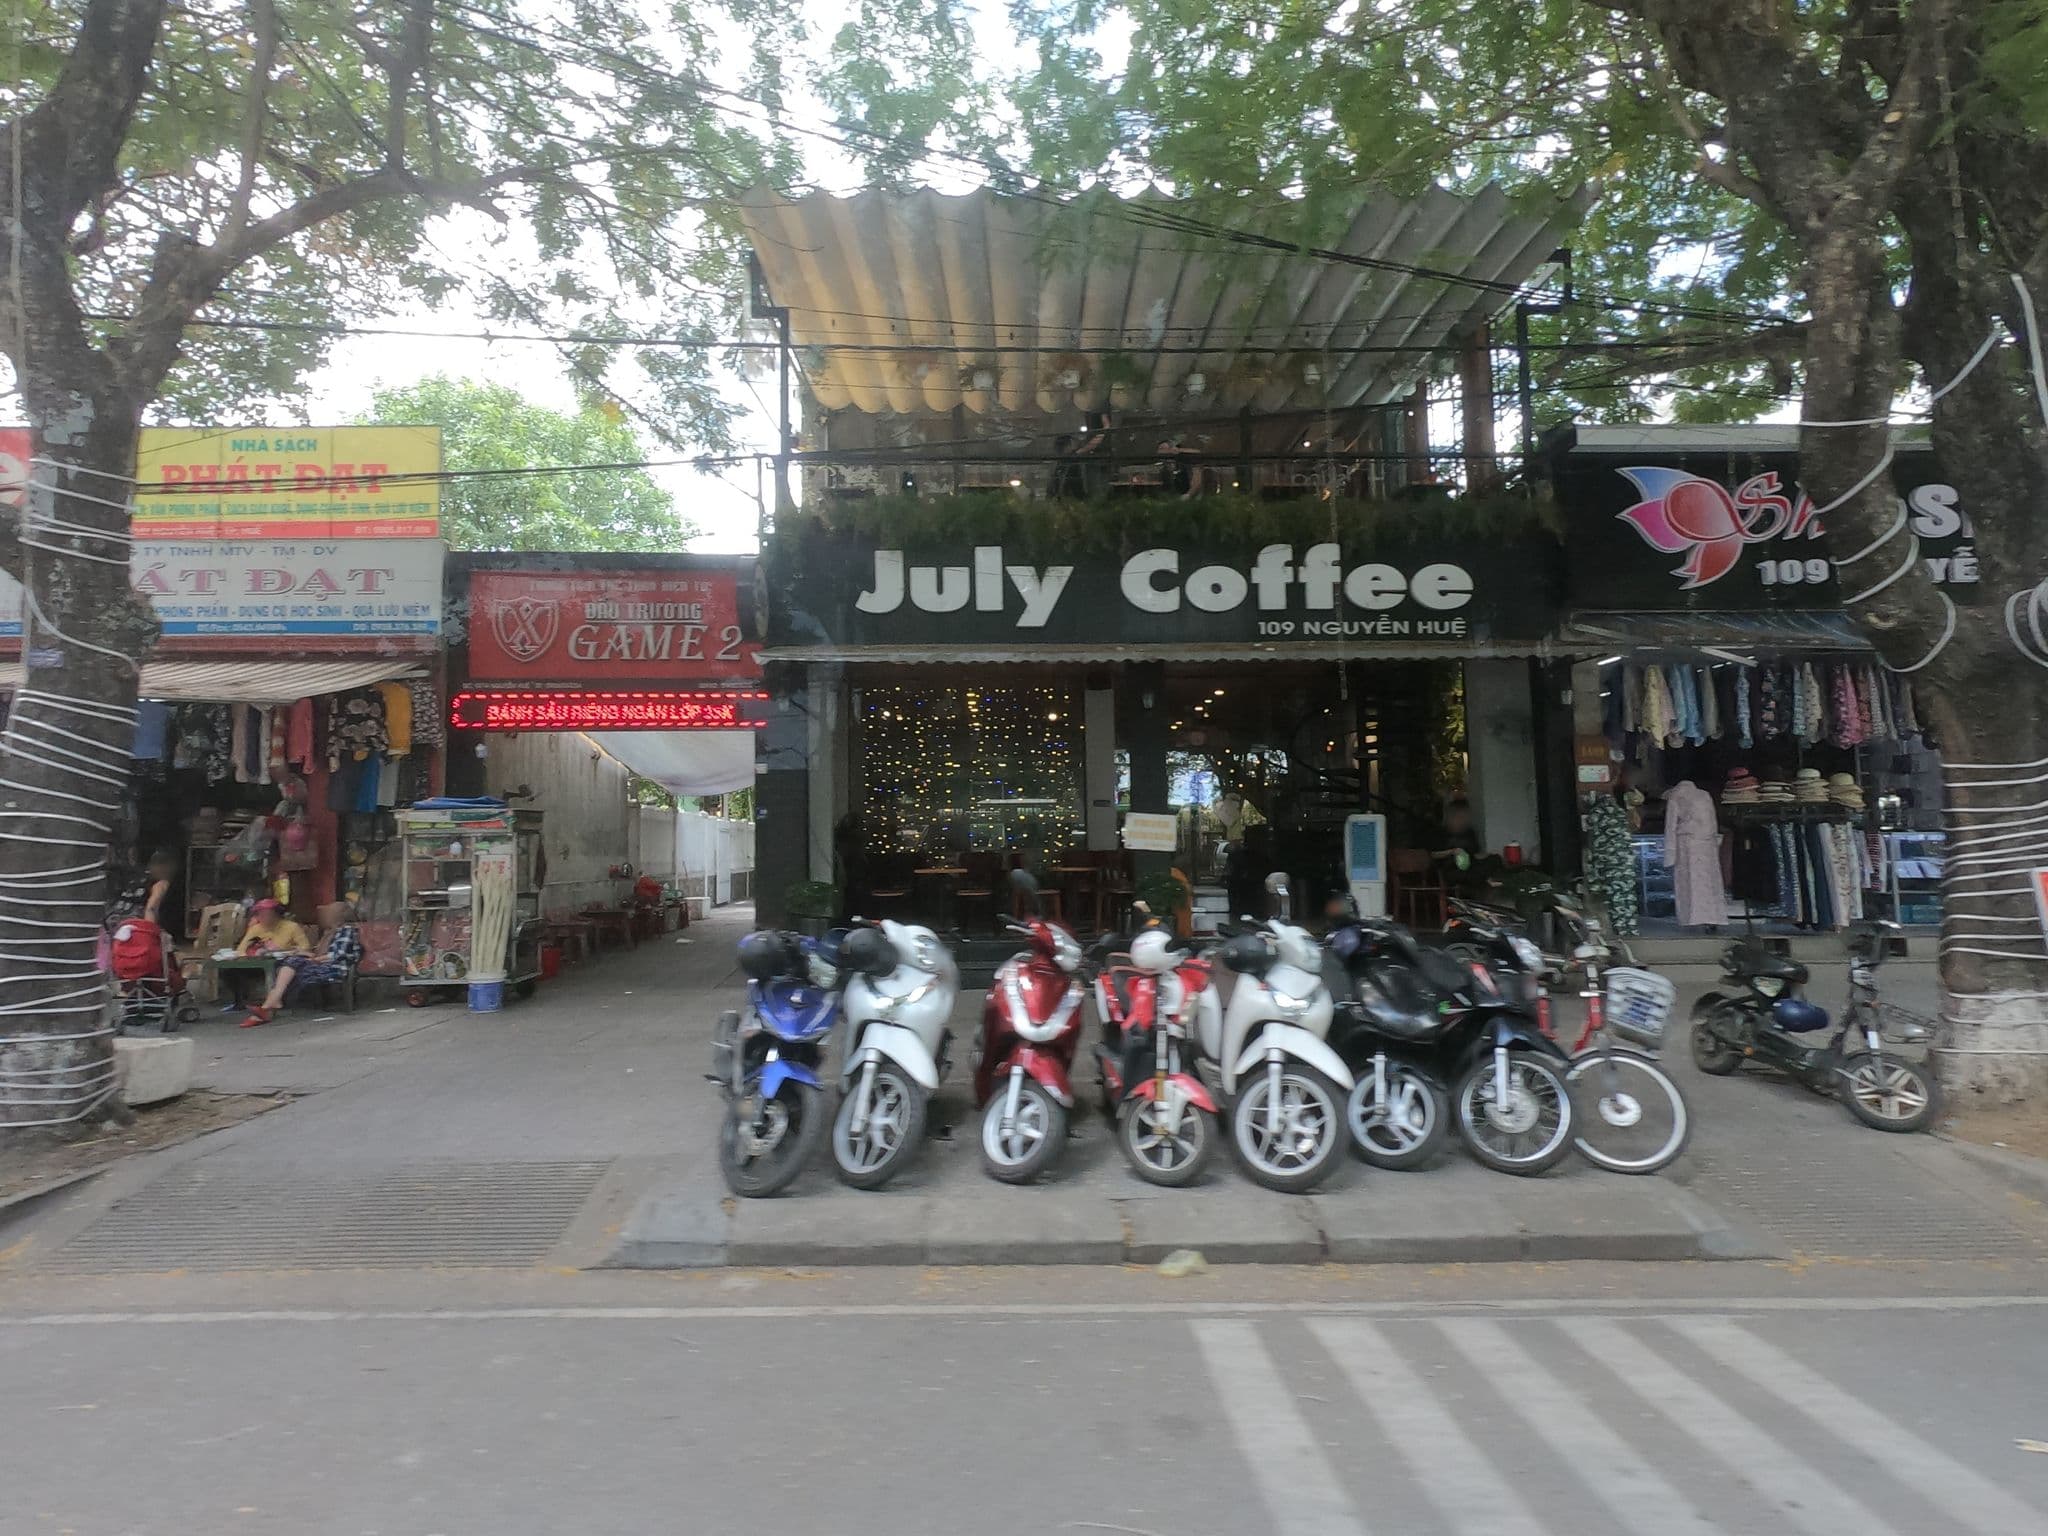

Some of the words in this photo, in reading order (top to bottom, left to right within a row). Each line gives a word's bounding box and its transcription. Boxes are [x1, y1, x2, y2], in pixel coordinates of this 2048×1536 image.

[231, 434, 269, 452] NHÀ
[274, 432, 318, 452] SÁCH
[161, 456, 282, 494] PHÁT
[295, 463, 388, 500] ĐẠT
[144, 546, 163, 557] TY
[170, 546, 213, 557] TNHH
[220, 546, 254, 557] MTV
[244, 568, 396, 601] ĐẠT
[855, 546, 1075, 627] July
[1120, 543, 1474, 613] Coffee
[1756, 558, 1830, 585] 109
[1258, 621, 1295, 635] 109
[1303, 614, 1410, 635] NGUYỄN
[1417, 617, 1467, 638] HUỆ
[567, 624, 708, 661] GAME
[714, 625, 744, 661] 2
